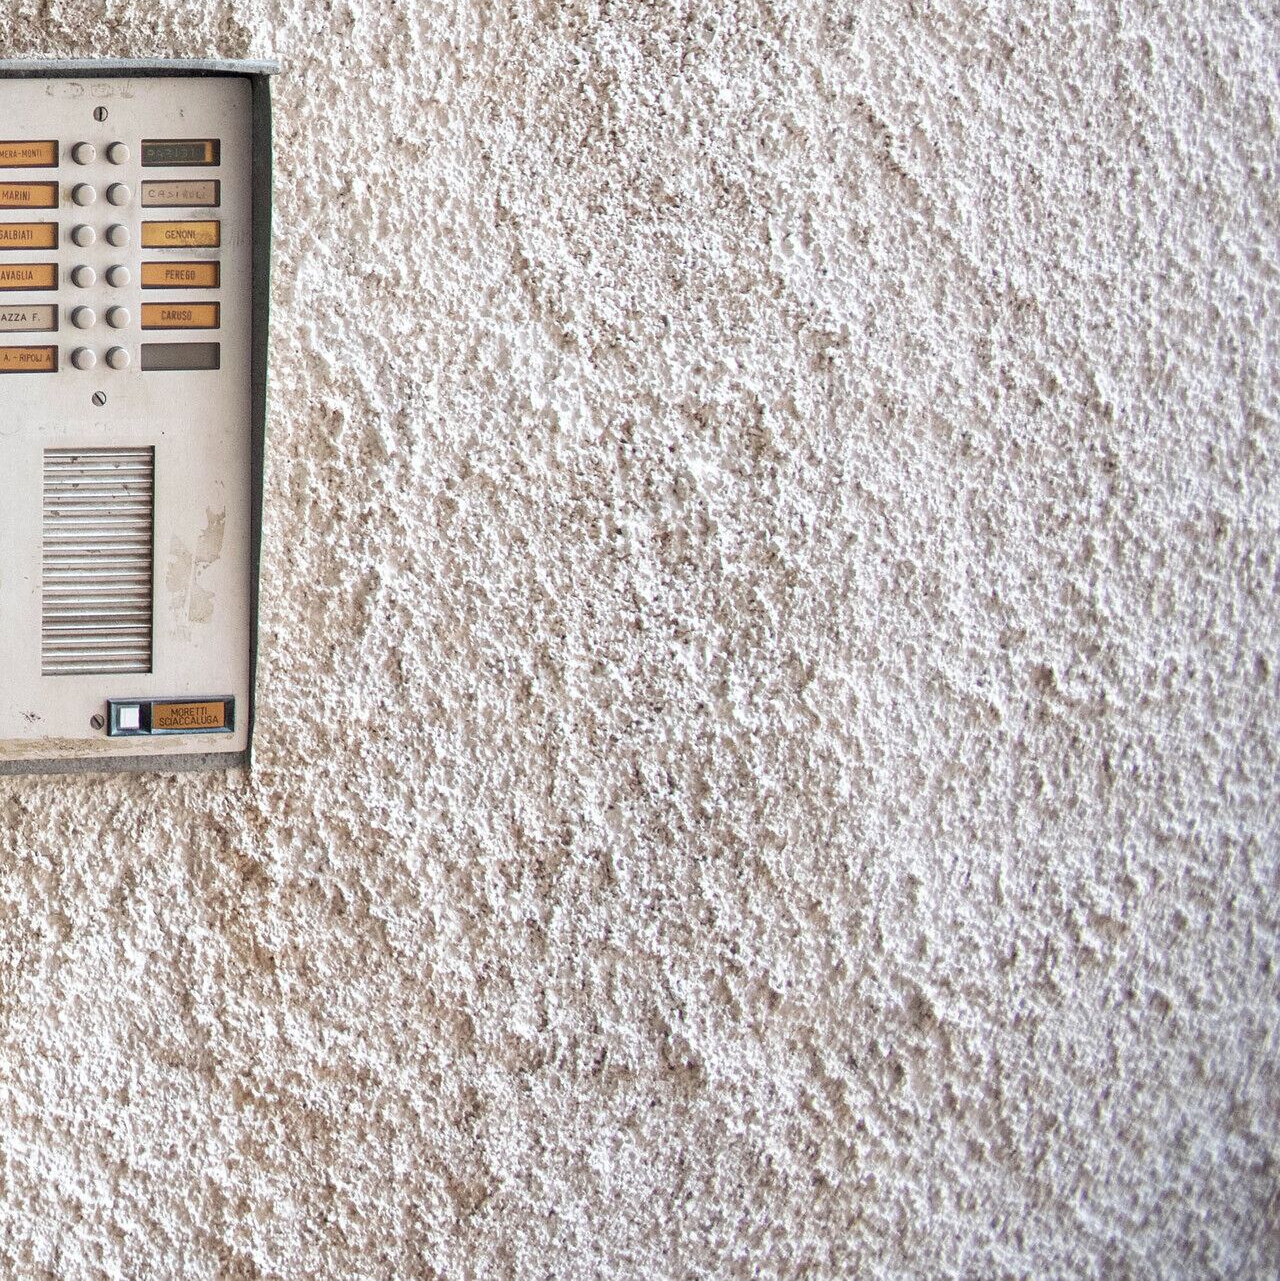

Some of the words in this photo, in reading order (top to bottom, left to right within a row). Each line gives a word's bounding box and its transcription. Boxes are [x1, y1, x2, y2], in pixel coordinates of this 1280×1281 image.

[1, 190, 31, 201] MARINI
[164, 230, 196, 240] GENONI
[165, 269, 196, 280] PEREGO
[32, 313, 41, 322] F.
[161, 310, 192, 321] CARUSO
[170, 707, 208, 718] MORETTI
[159, 716, 219, 727] SCIACCALUGA
